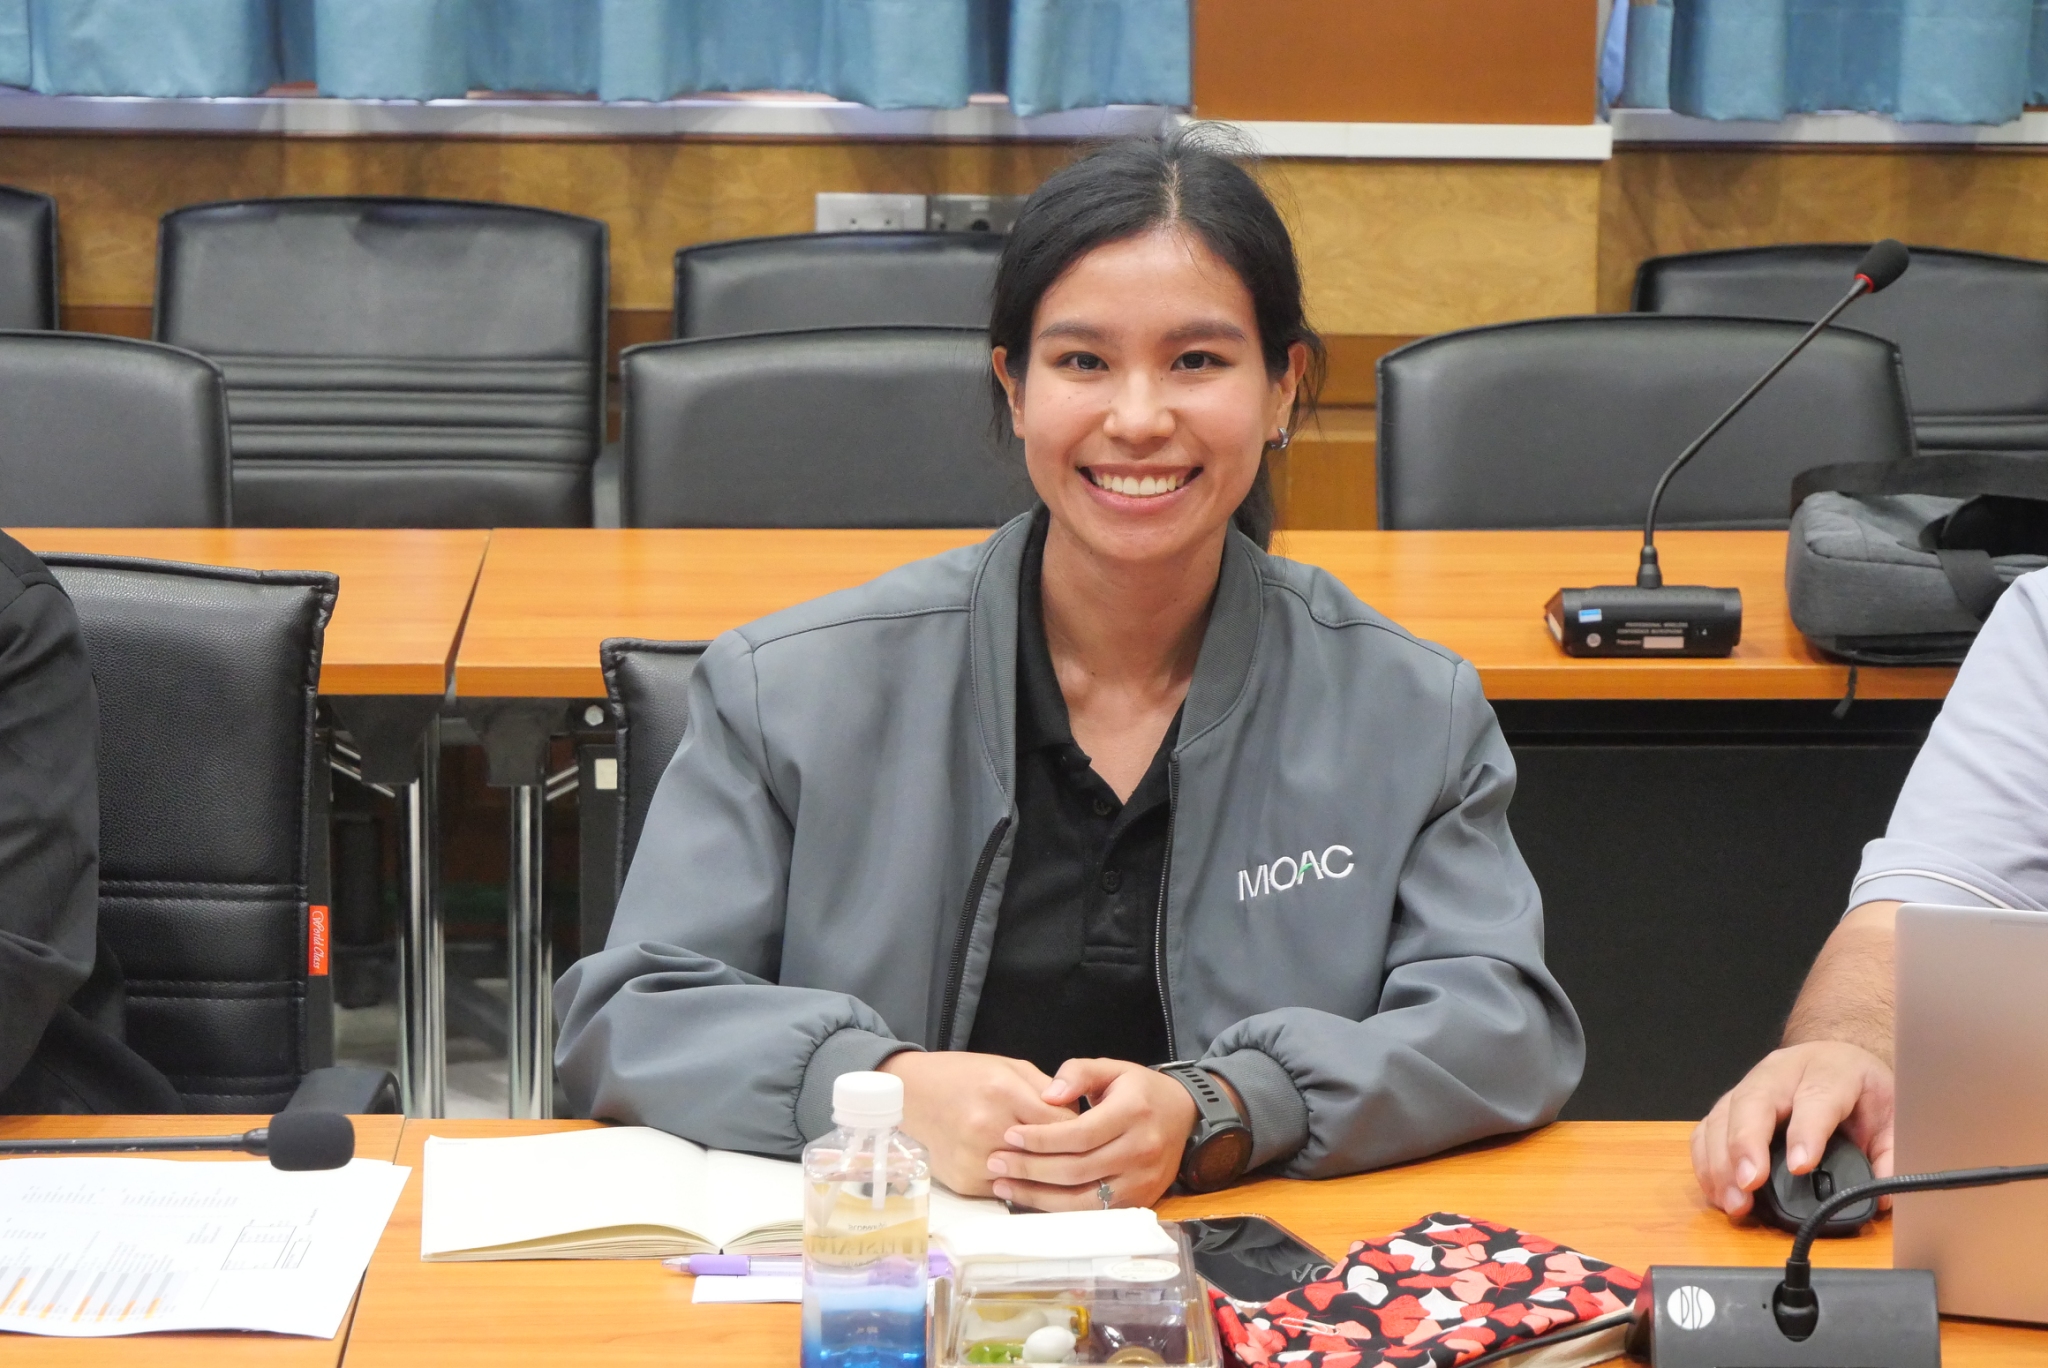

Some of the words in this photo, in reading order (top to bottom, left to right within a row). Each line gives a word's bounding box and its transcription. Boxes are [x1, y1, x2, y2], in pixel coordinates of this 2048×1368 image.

[1238, 844, 1355, 901] MOAC
[312, 910, 325, 946] World
[313, 947, 325, 969] Class
